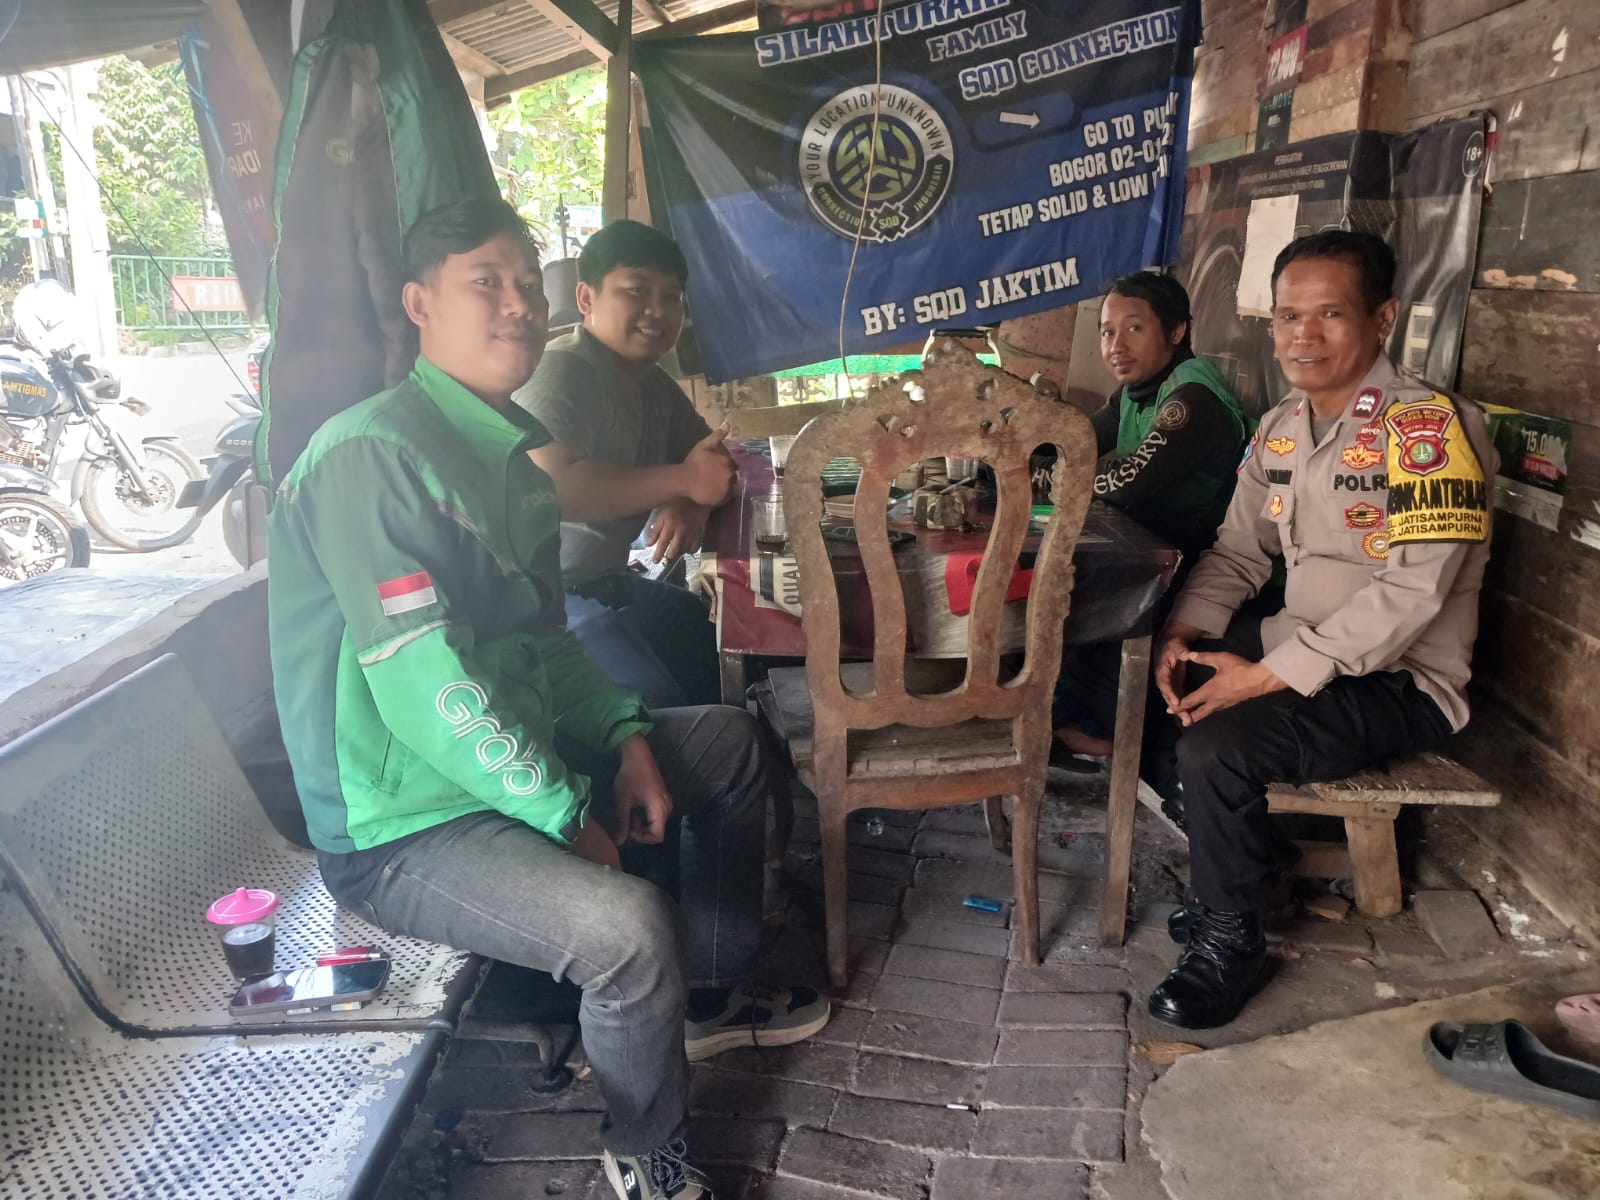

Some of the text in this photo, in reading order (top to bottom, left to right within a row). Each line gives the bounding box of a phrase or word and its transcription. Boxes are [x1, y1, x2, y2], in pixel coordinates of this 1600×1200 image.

[926, 10, 1027, 62] FAMILY
[959, 58, 1017, 101] SQD
[806, 143, 823, 180] YOUR
[888, 93, 945, 151] UNKNOWN
[1083, 121, 1110, 149] GO
[1111, 113, 1136, 141] TO
[1048, 152, 1109, 188] BOGOR
[1465, 146, 1482, 161] 18+
[977, 202, 1034, 237] TETAP
[1037, 189, 1088, 223] SOLID
[1092, 184, 1108, 209] &
[1109, 172, 1149, 204] LOW
[860, 257, 1080, 336] BY: SQD JAKTIM
[1398, 512, 1483, 526] JATISAMPURNA
[1398, 522, 1483, 537] JATISAMPURNA
[435, 680, 543, 797] Grab
